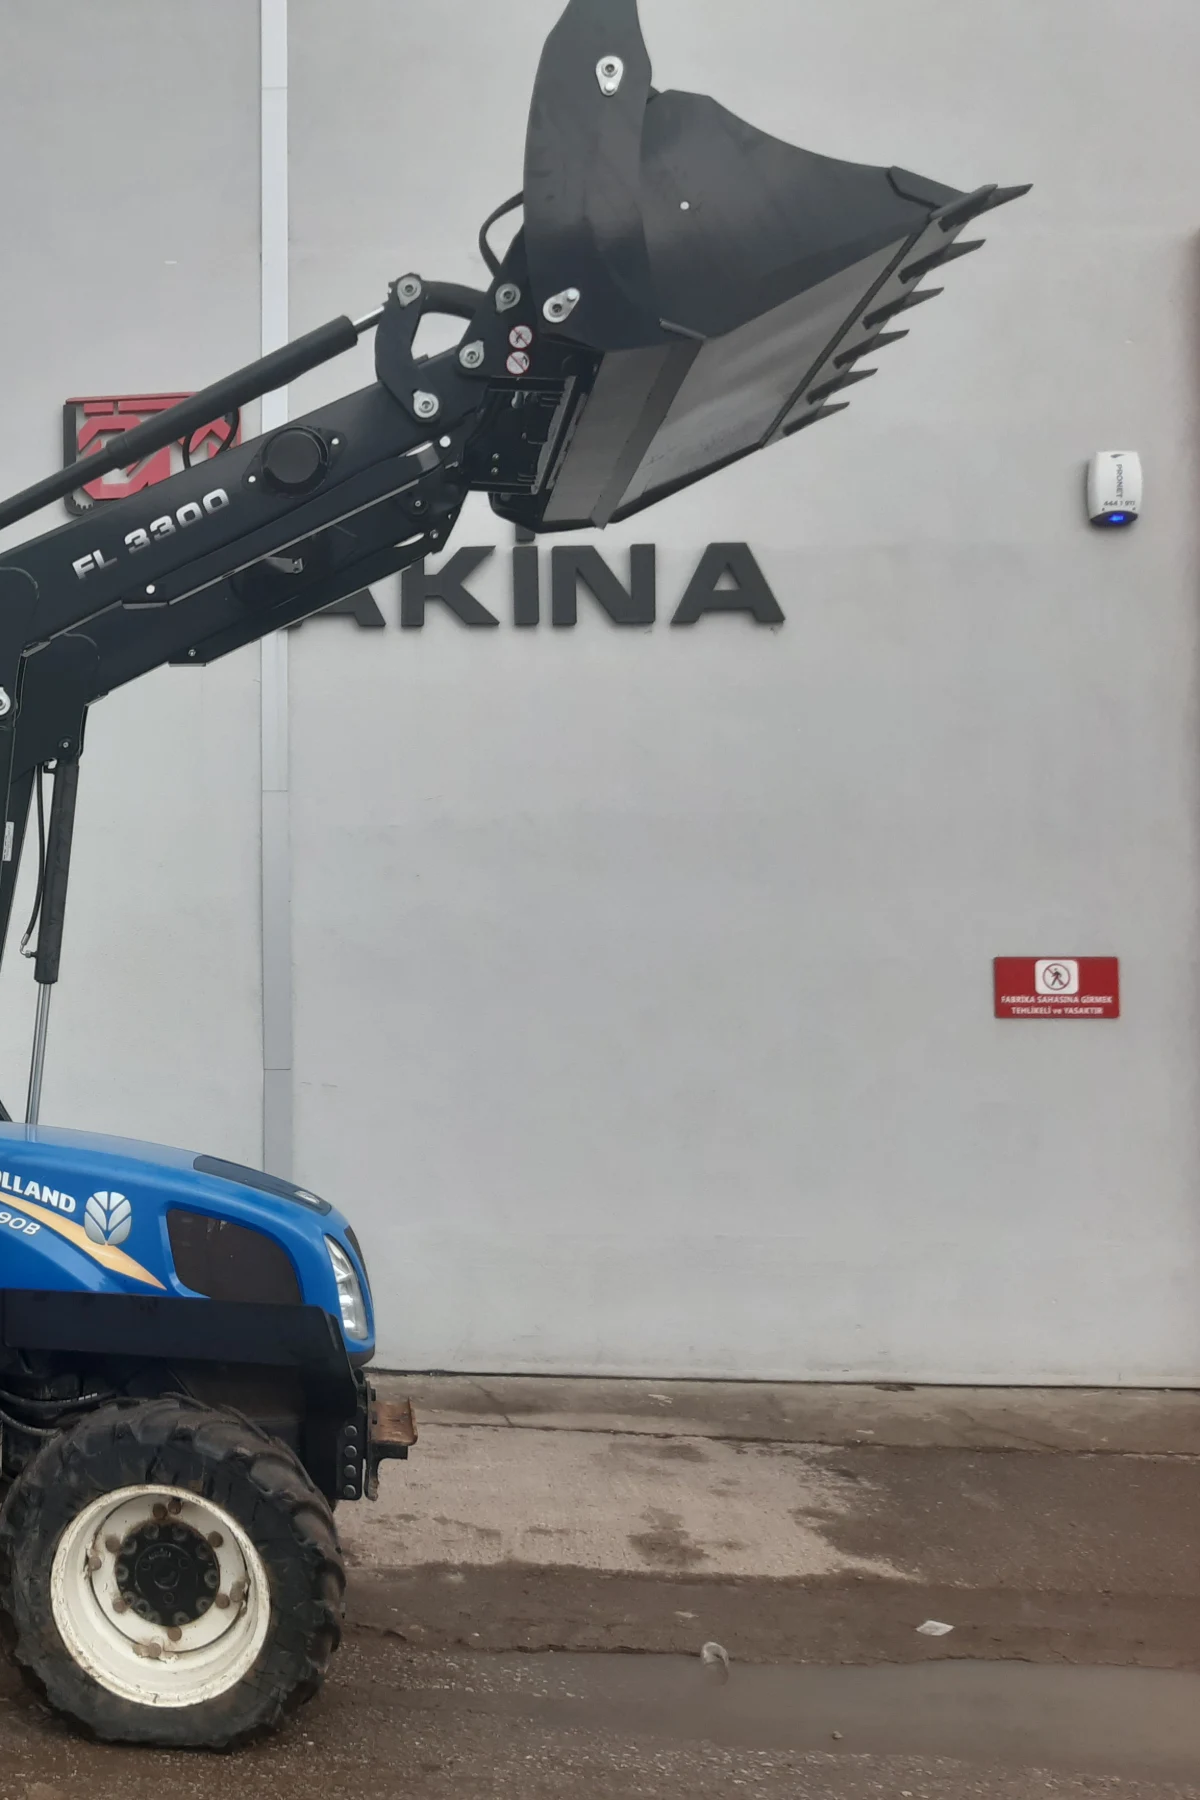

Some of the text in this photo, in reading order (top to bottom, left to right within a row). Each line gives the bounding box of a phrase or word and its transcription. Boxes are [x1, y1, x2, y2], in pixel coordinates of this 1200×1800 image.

[1116, 463, 1124, 498] PRONET
[72, 487, 230, 580] FL 3300
